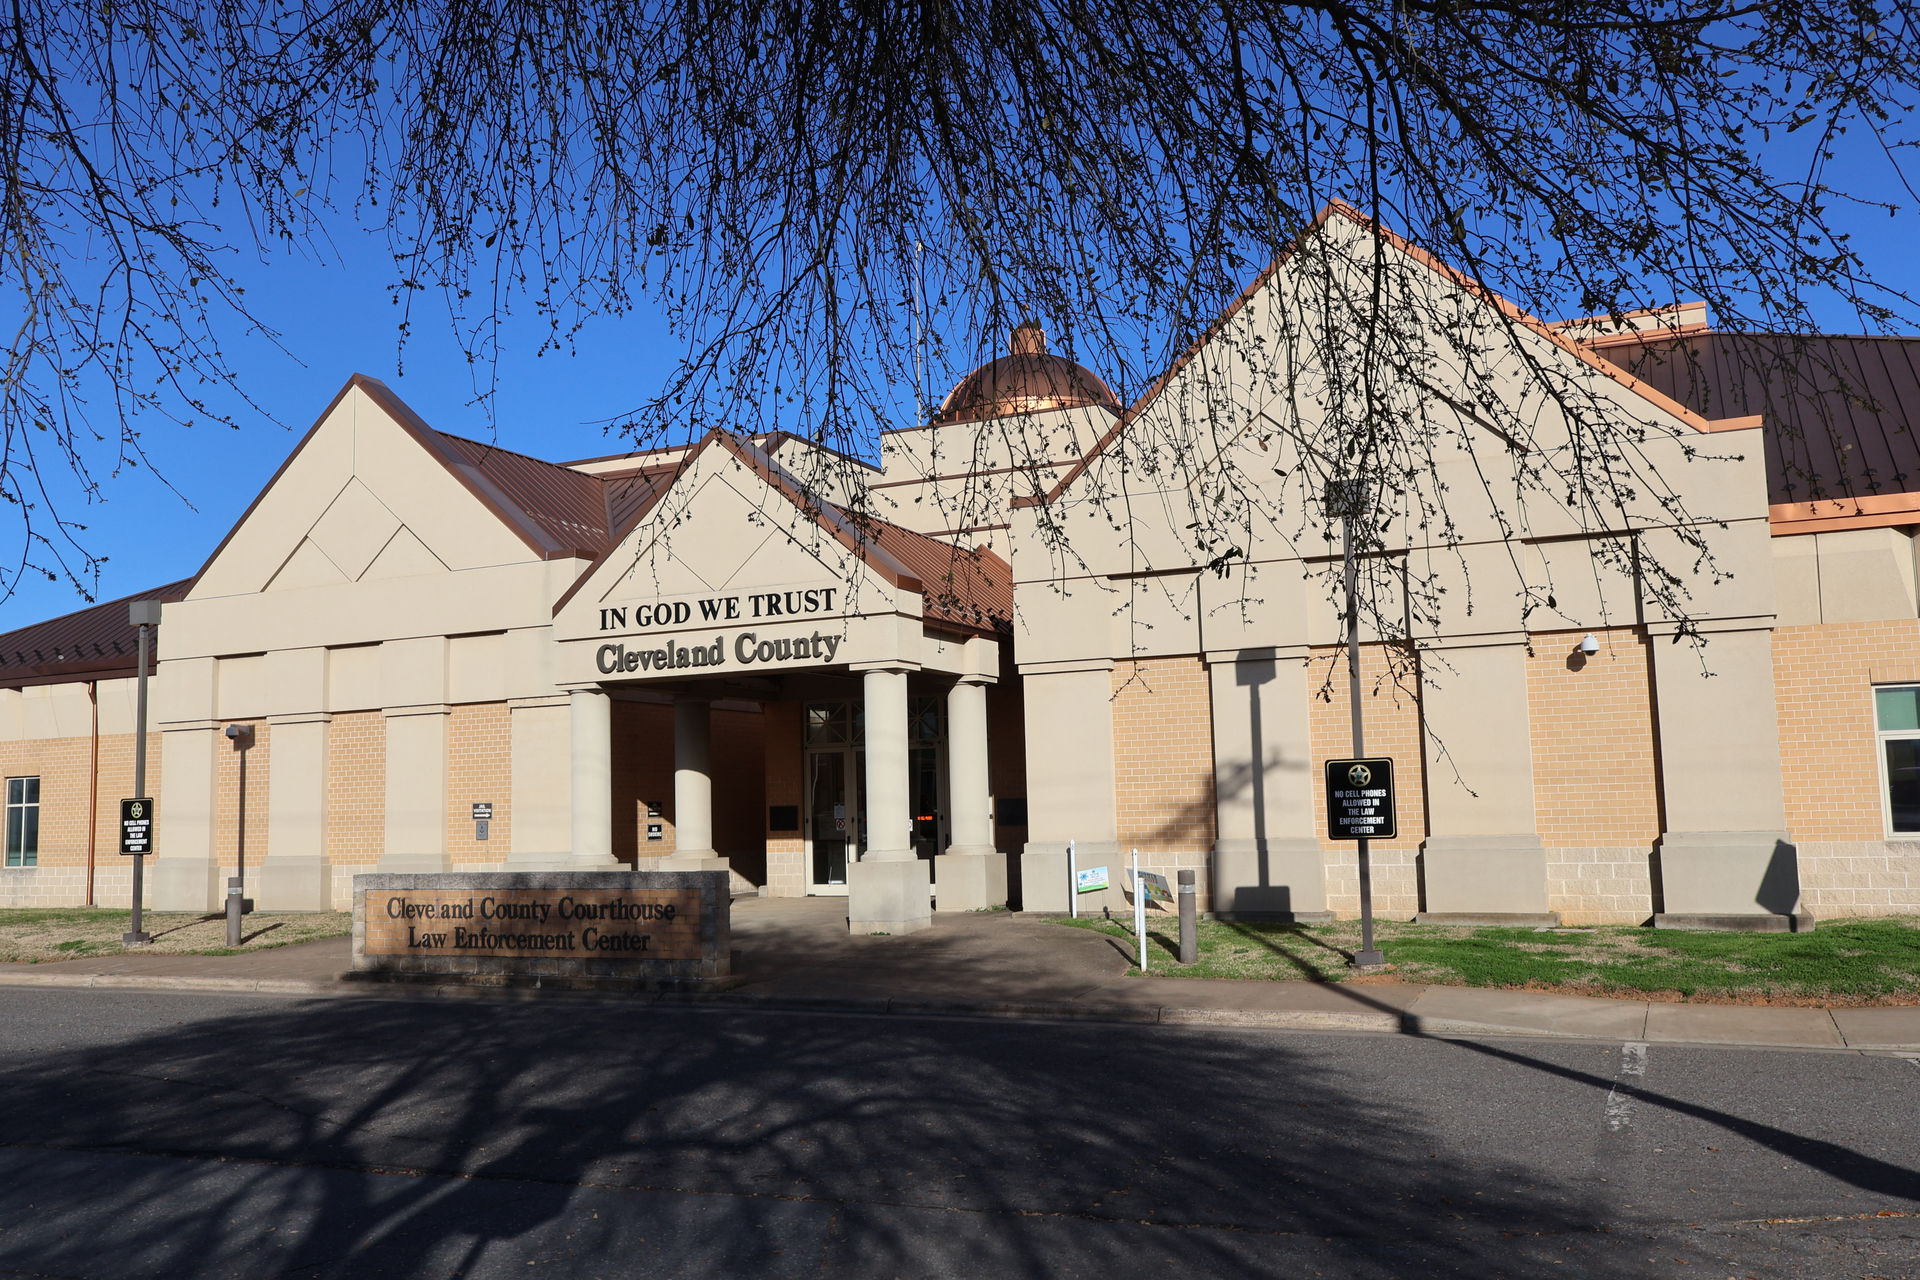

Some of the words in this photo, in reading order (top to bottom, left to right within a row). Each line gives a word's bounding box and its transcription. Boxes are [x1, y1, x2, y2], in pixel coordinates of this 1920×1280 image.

[600, 607, 628, 631] IN
[636, 601, 691, 627] GOD
[698, 596, 740, 621] WE
[748, 588, 837, 617] TRUST
[596, 635, 726, 674] Cleveland
[735, 630, 842, 664] County
[1334, 790, 1344, 798] NO
[1345, 790, 1360, 798] CELL
[1361, 789, 1387, 797] PHONES
[1342, 799, 1371, 807] ALLOWED
[1372, 798, 1380, 806] IN
[1348, 808, 1359, 816] THE
[1339, 817, 1385, 825] ENFORCEMENT
[1350, 826, 1375, 834] CENTER
[387, 897, 474, 919] Cleveand
[480, 896, 551, 924] County
[558, 896, 676, 920] Courthouse
[408, 926, 447, 949] Law
[454, 926, 575, 950] Enforcement
[582, 927, 651, 950] Center
